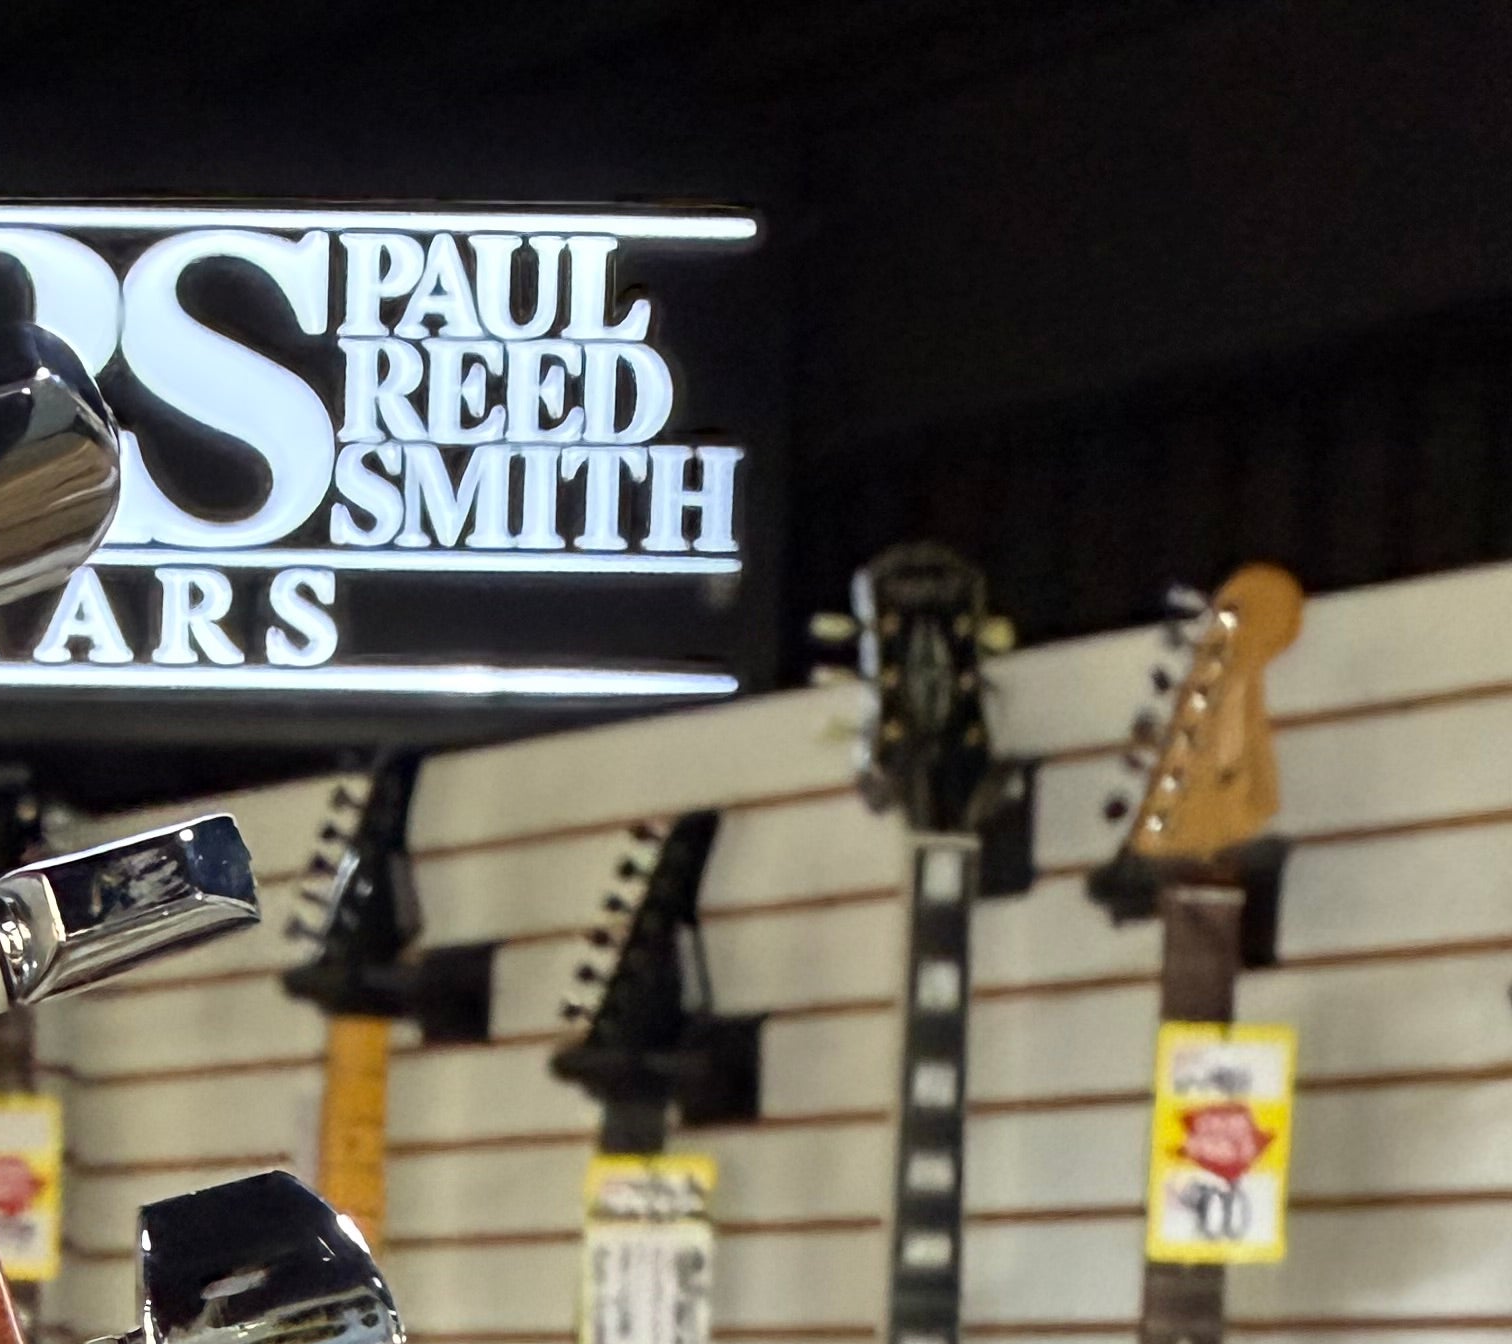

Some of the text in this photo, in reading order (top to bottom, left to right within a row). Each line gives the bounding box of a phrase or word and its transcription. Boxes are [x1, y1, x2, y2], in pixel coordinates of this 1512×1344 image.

[337, 232, 651, 341] PAUL
[337, 336, 674, 445] REED
[329, 442, 744, 552] SMITH
